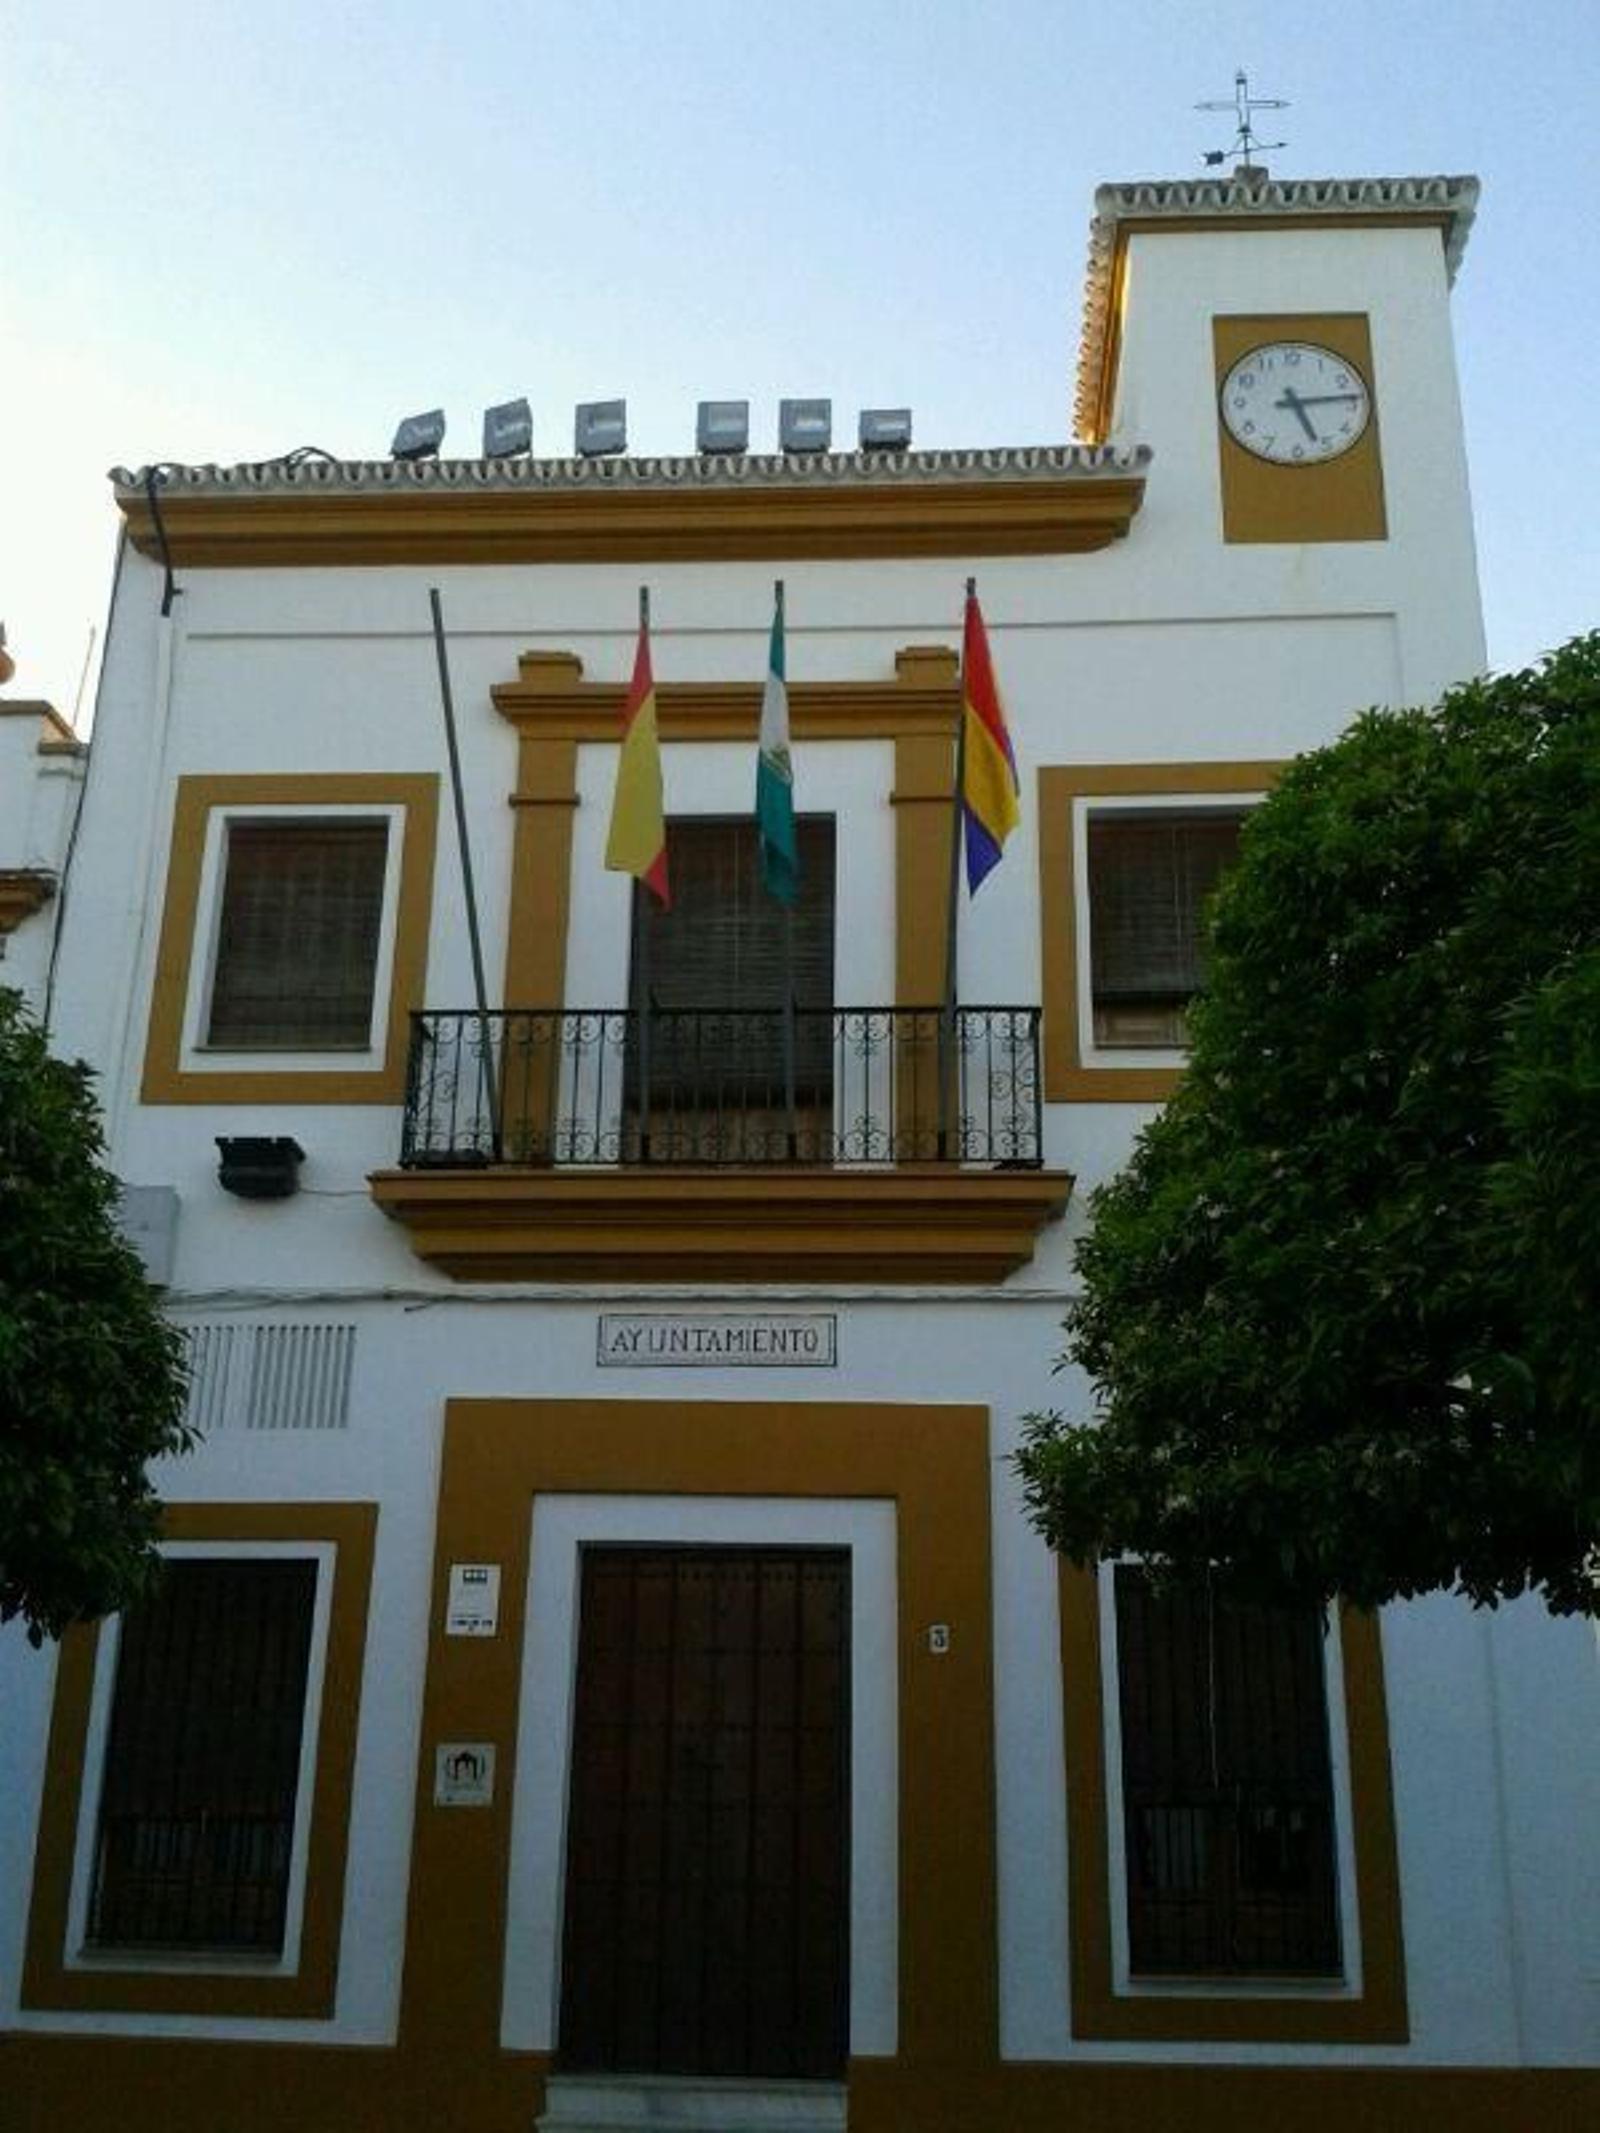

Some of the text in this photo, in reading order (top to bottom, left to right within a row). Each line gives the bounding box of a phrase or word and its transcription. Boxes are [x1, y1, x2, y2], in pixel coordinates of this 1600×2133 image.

[1259, 357, 1273, 371] 11
[1284, 352, 1300, 366] 12
[1239, 374, 1254, 388] 10
[610, 1328, 819, 1352] AYUNTAMIENTO
